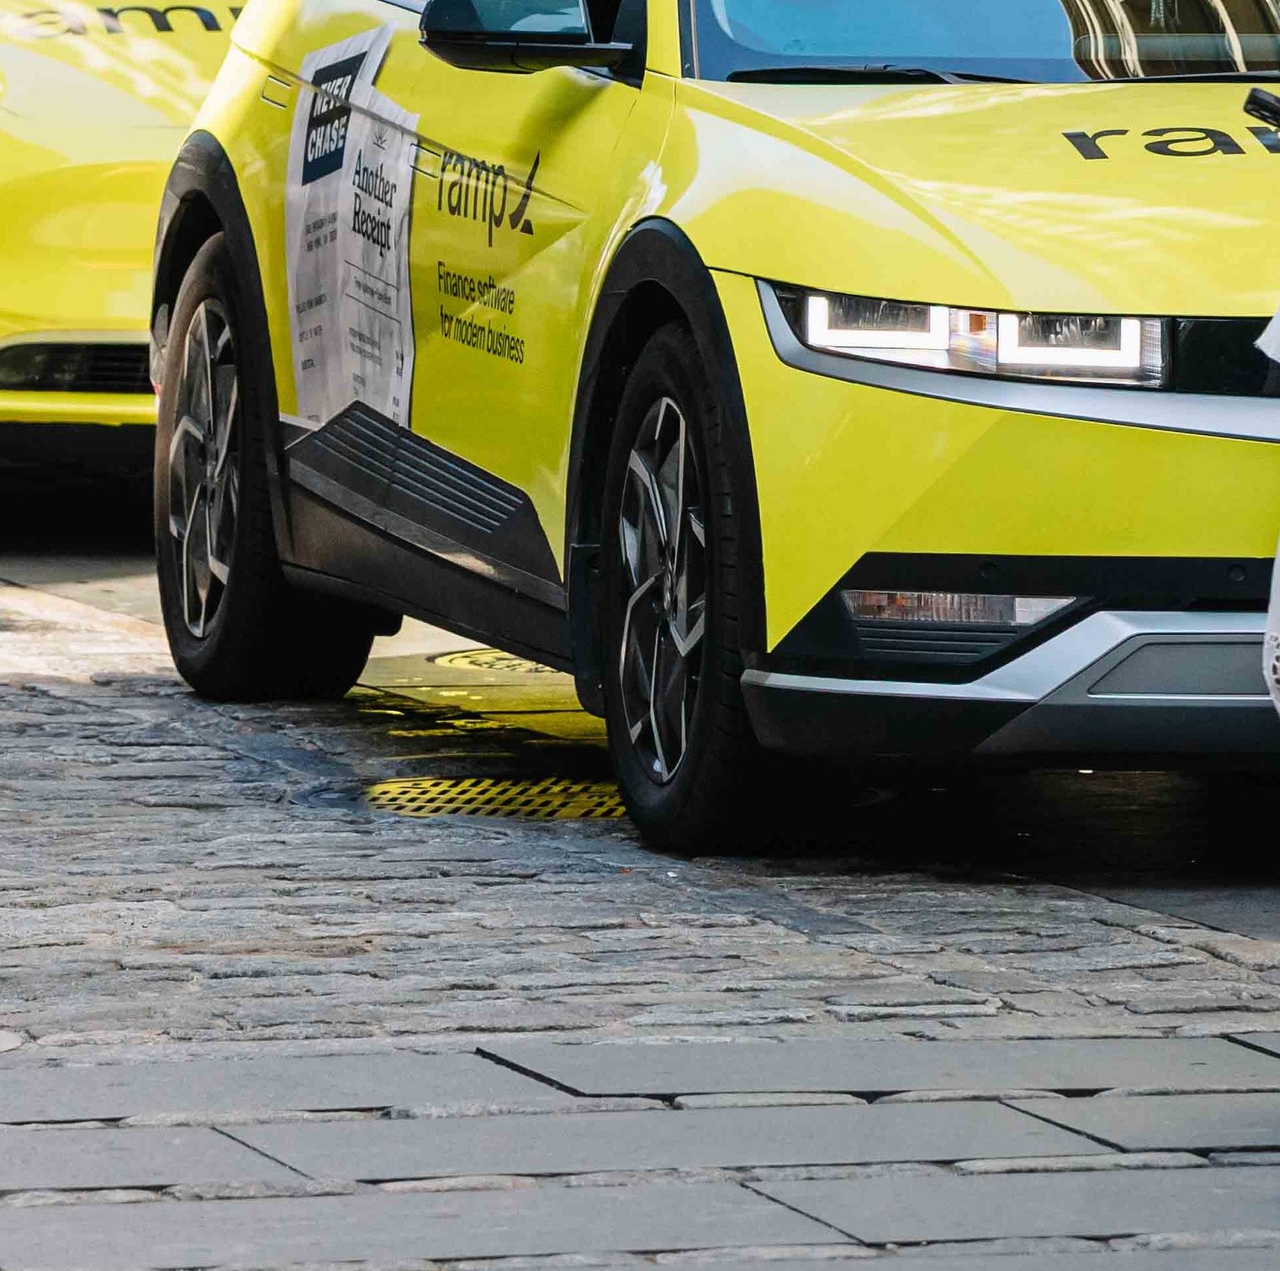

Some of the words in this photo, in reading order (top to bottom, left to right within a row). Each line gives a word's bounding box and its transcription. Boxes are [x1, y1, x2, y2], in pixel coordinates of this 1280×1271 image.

[313, 75, 352, 117] NEVER
[307, 119, 347, 162] CHASE
[352, 149, 397, 209] Another
[437, 150, 508, 247] ramp
[352, 192, 391, 257] Receipt
[437, 261, 476, 302] Finance
[477, 275, 515, 315] software
[439, 304, 454, 339] for
[453, 314, 486, 348] modern
[486, 321, 525, 364] business
